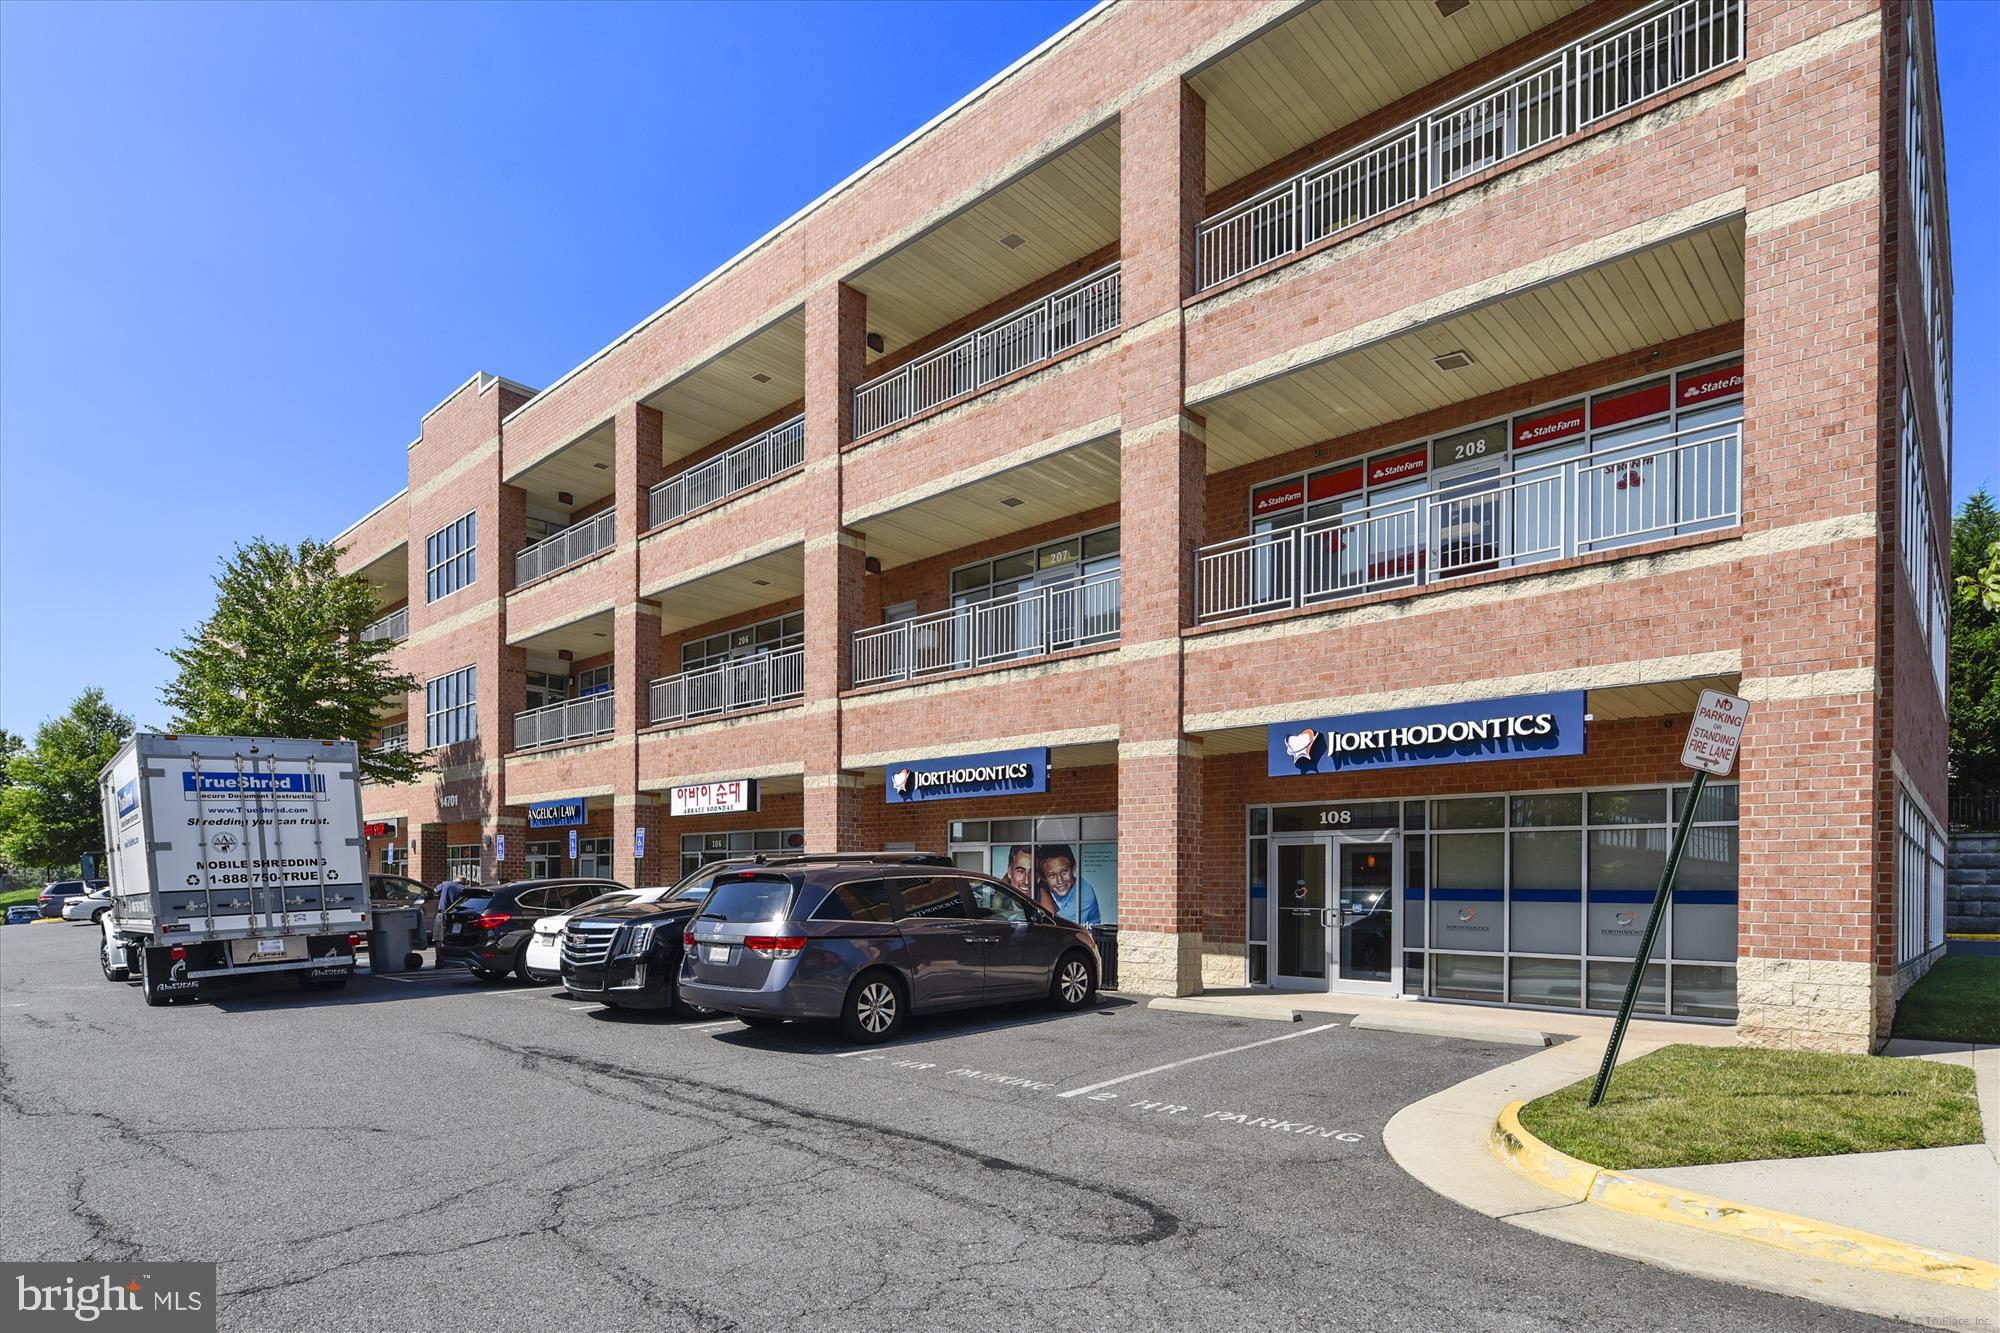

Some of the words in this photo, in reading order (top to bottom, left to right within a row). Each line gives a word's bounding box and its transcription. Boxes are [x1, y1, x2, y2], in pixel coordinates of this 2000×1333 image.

[1455, 439, 1486, 460] 208
[1050, 550, 1068, 564] 207
[1715, 698, 1733, 711] NO
[1699, 707, 1742, 727] PARKING
[1693, 727, 1736, 747] STANDING
[1688, 739, 1708, 754] FIRE
[1709, 744, 1733, 761] LANE
[192, 775, 291, 789] TrueShred
[677, 785, 711, 808] 아바이
[716, 782, 741, 805] 순대
[528, 807, 558, 820] ANGELICA
[561, 805, 576, 817] LAW
[1319, 810, 1351, 824] 108
[252, 819, 273, 827] you
[712, 840, 722, 848] 106
[196, 860, 248, 870] MOBILE
[252, 858, 327, 868] SHREDDING
[209, 871, 319, 885] 1-888-750-TRUE
[1087, 1093, 1118, 1101] 2
[1130, 1099, 1188, 1114] HR
[1202, 1110, 1366, 1142] PARKING
